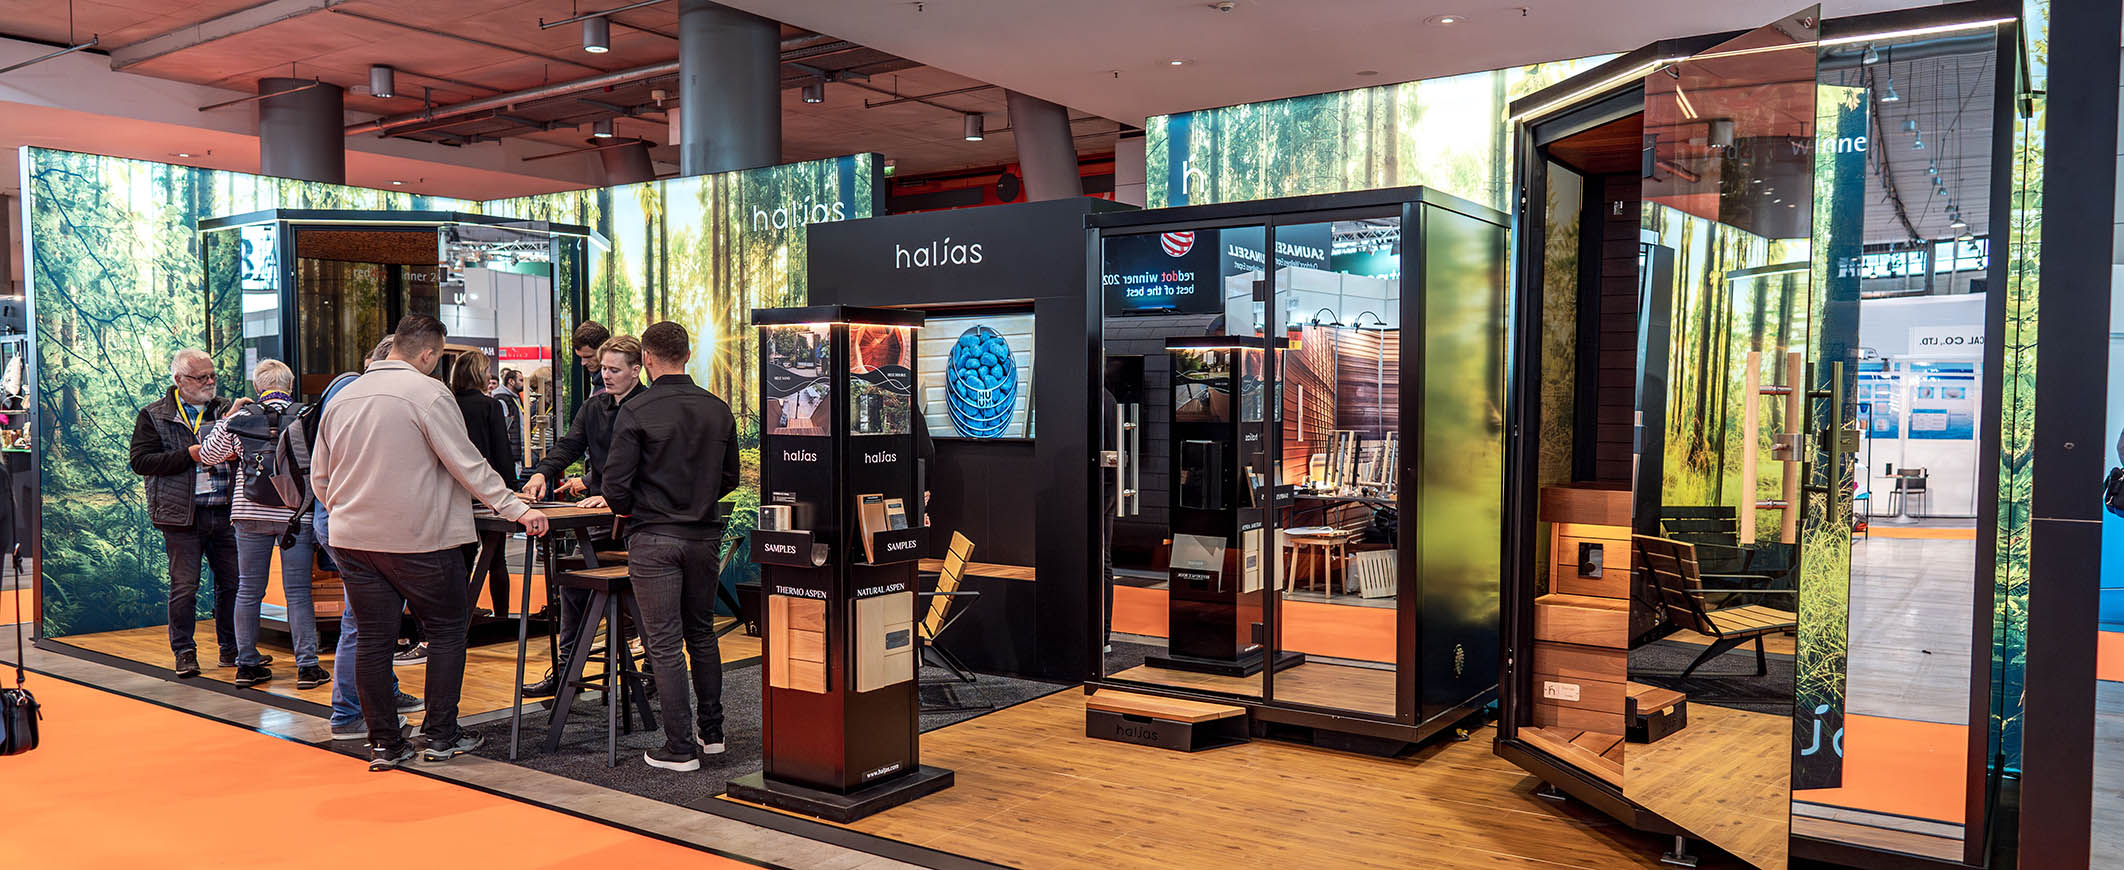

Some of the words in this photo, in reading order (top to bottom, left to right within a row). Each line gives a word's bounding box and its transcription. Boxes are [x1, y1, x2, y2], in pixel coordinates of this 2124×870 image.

[753, 195, 845, 232] haljas
[895, 237, 983, 269] haljas
[401, 270, 428, 281] inner
[783, 450, 817, 462] haljas
[864, 450, 897, 464] haljas
[764, 543, 797, 554] SAMPLES
[886, 539, 917, 552] SAMPLES
[776, 585, 804, 597] THERMO
[804, 588, 827, 599] ASPEN
[856, 586, 884, 597] NATURAL
[884, 583, 905, 592] ASPEN
